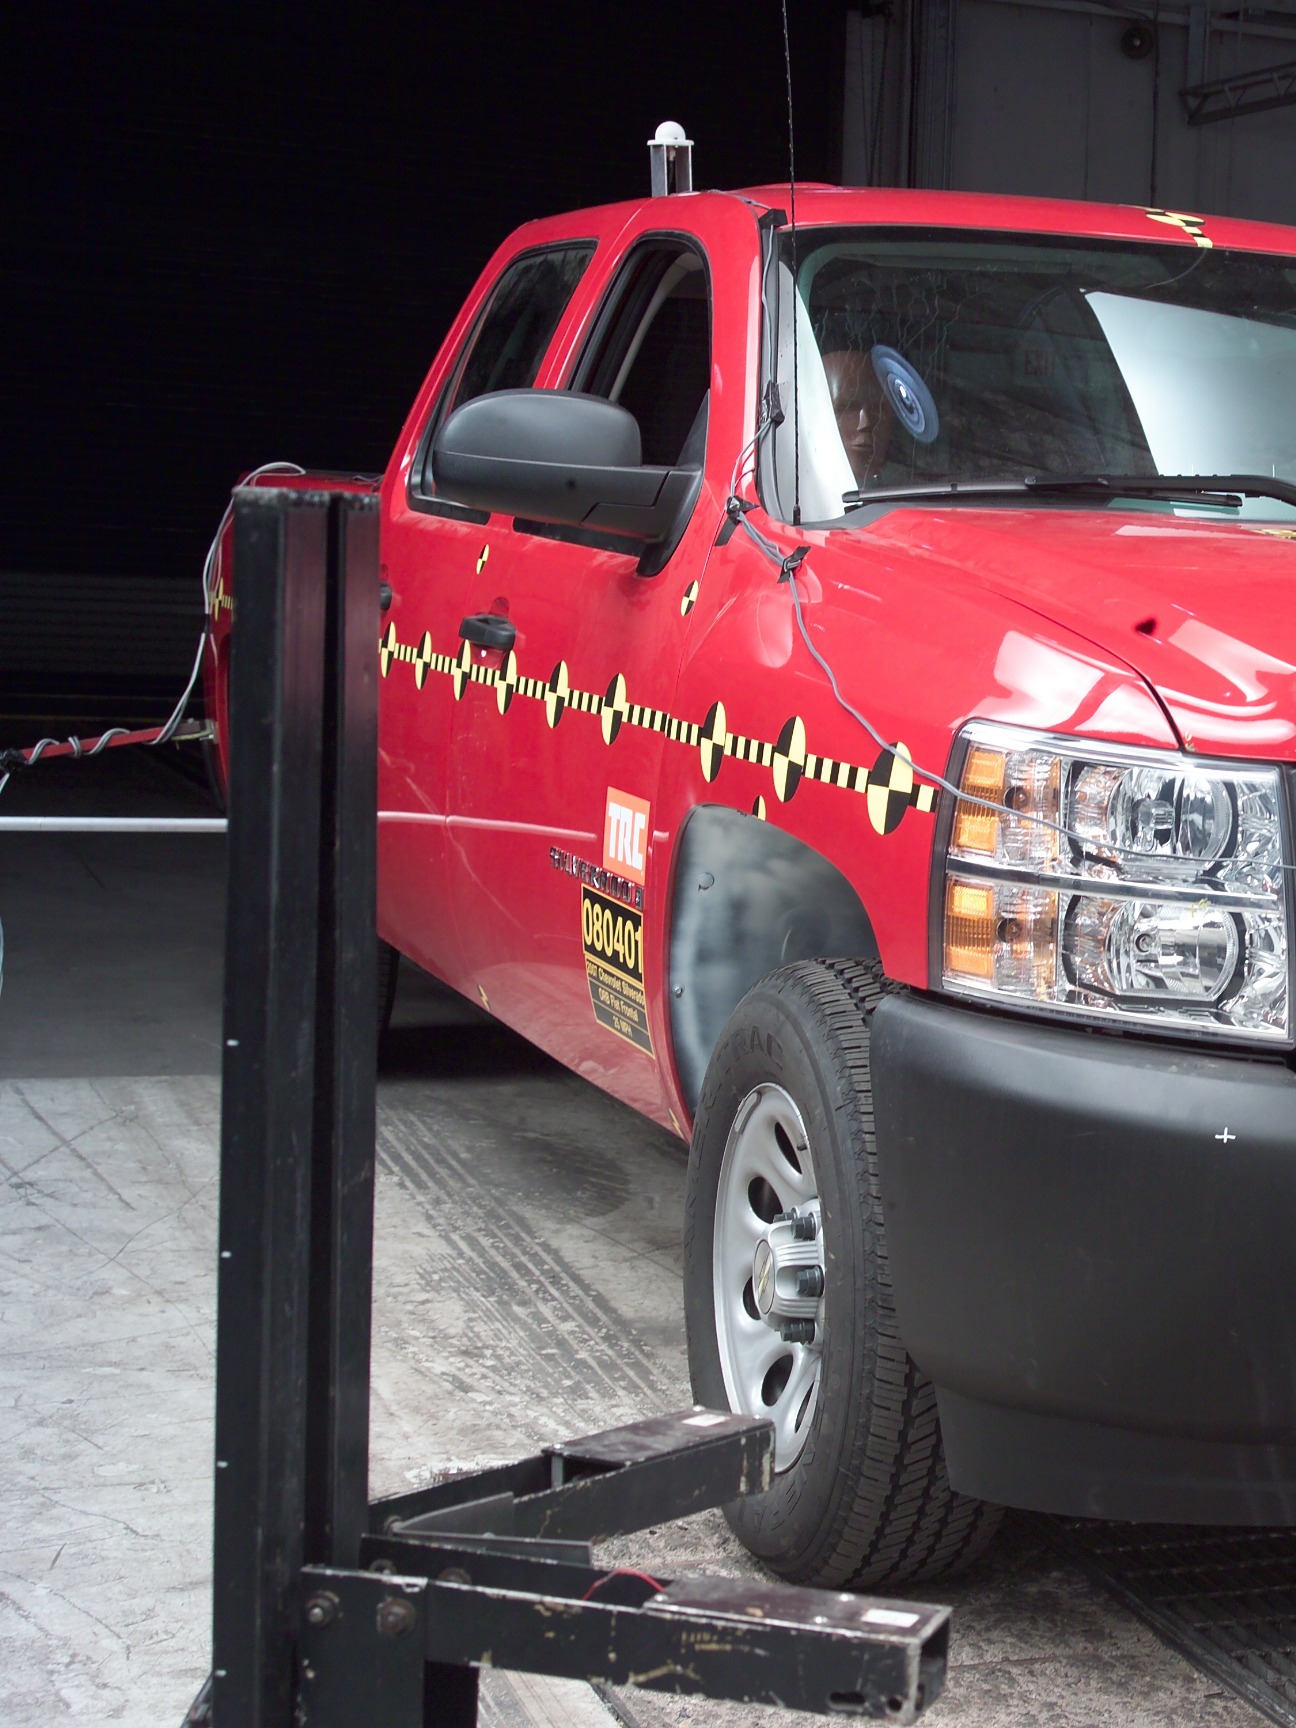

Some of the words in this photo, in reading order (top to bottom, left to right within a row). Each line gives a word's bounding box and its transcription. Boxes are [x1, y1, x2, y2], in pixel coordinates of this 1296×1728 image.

[608, 802, 646, 870] TRC
[583, 898, 643, 973] 080401
[598, 967, 621, 992] Chevrolet
[622, 980, 645, 1006] Silverado
[610, 994, 621, 1011] Flat
[620, 1000, 639, 1022] Frontal
[620, 1019, 633, 1038] MPH
